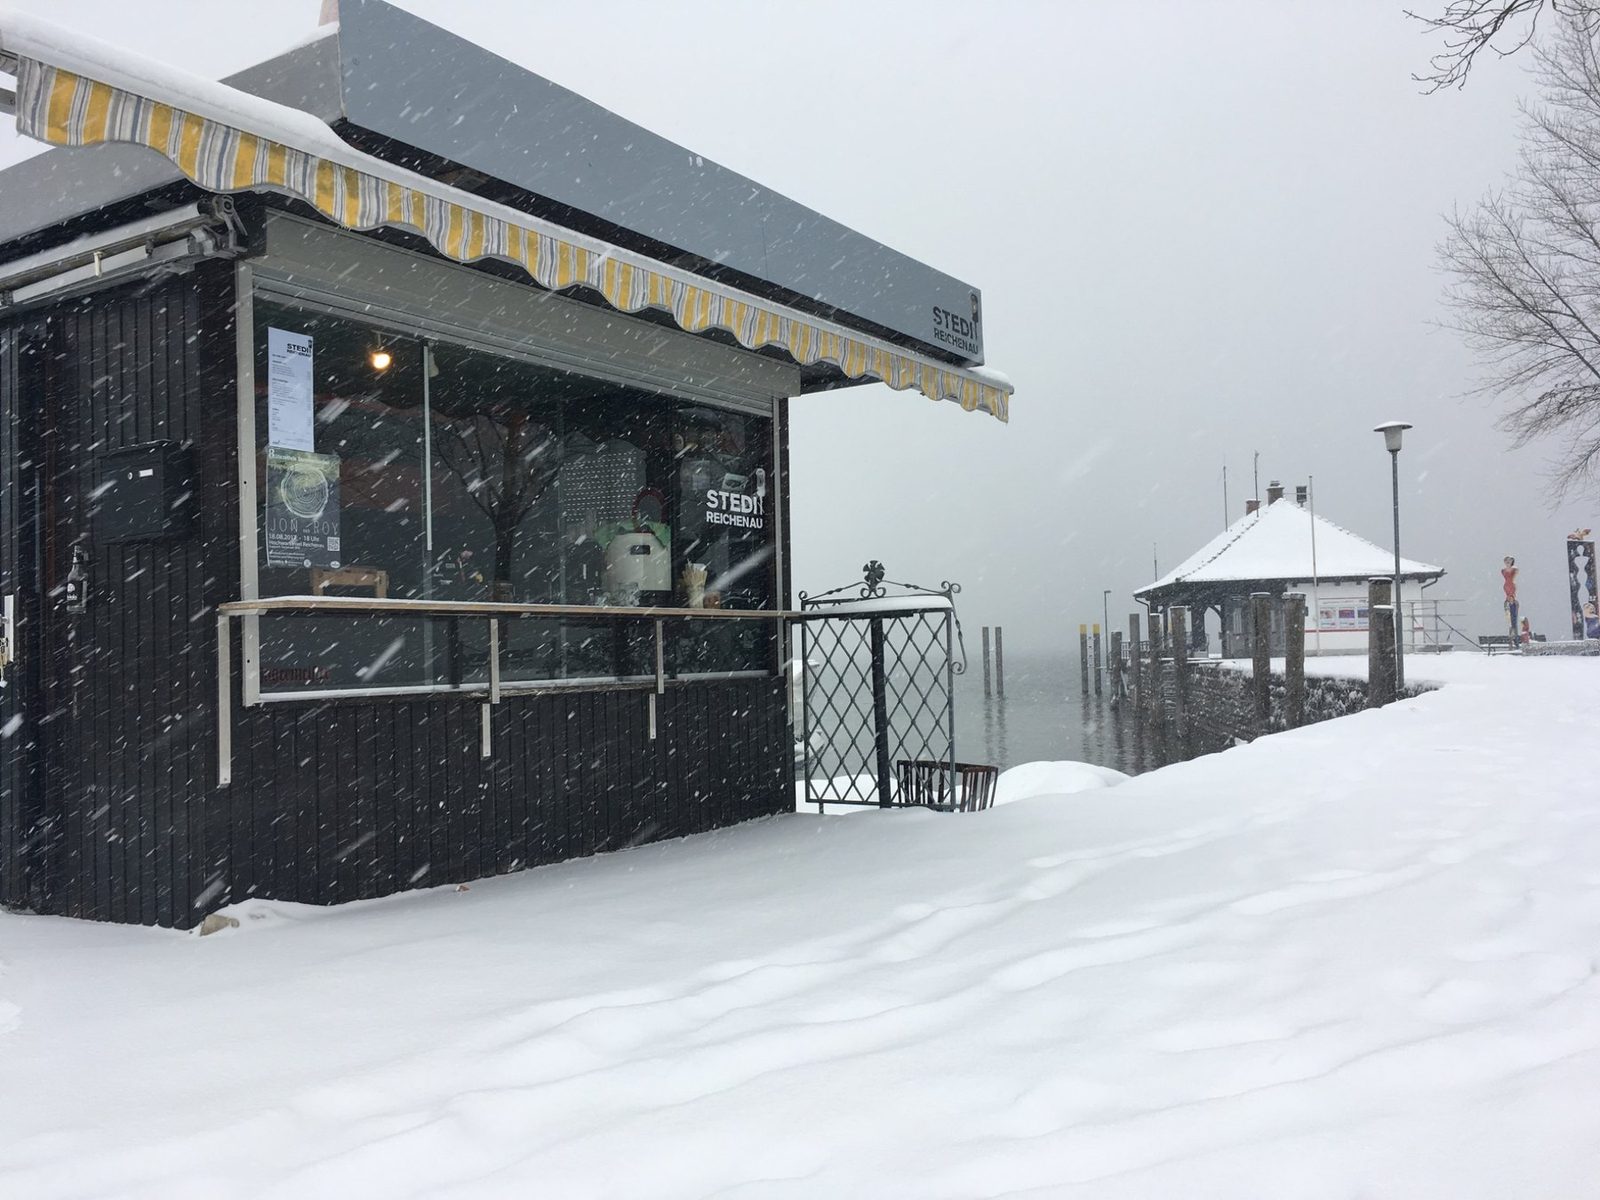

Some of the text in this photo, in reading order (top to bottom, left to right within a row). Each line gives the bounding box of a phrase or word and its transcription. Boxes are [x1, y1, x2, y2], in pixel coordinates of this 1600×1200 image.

[934, 327, 979, 355] REICHENAU
[270, 517, 298, 532] JON
[313, 520, 339, 536] ROY
[706, 511, 763, 529] REICHENAU
